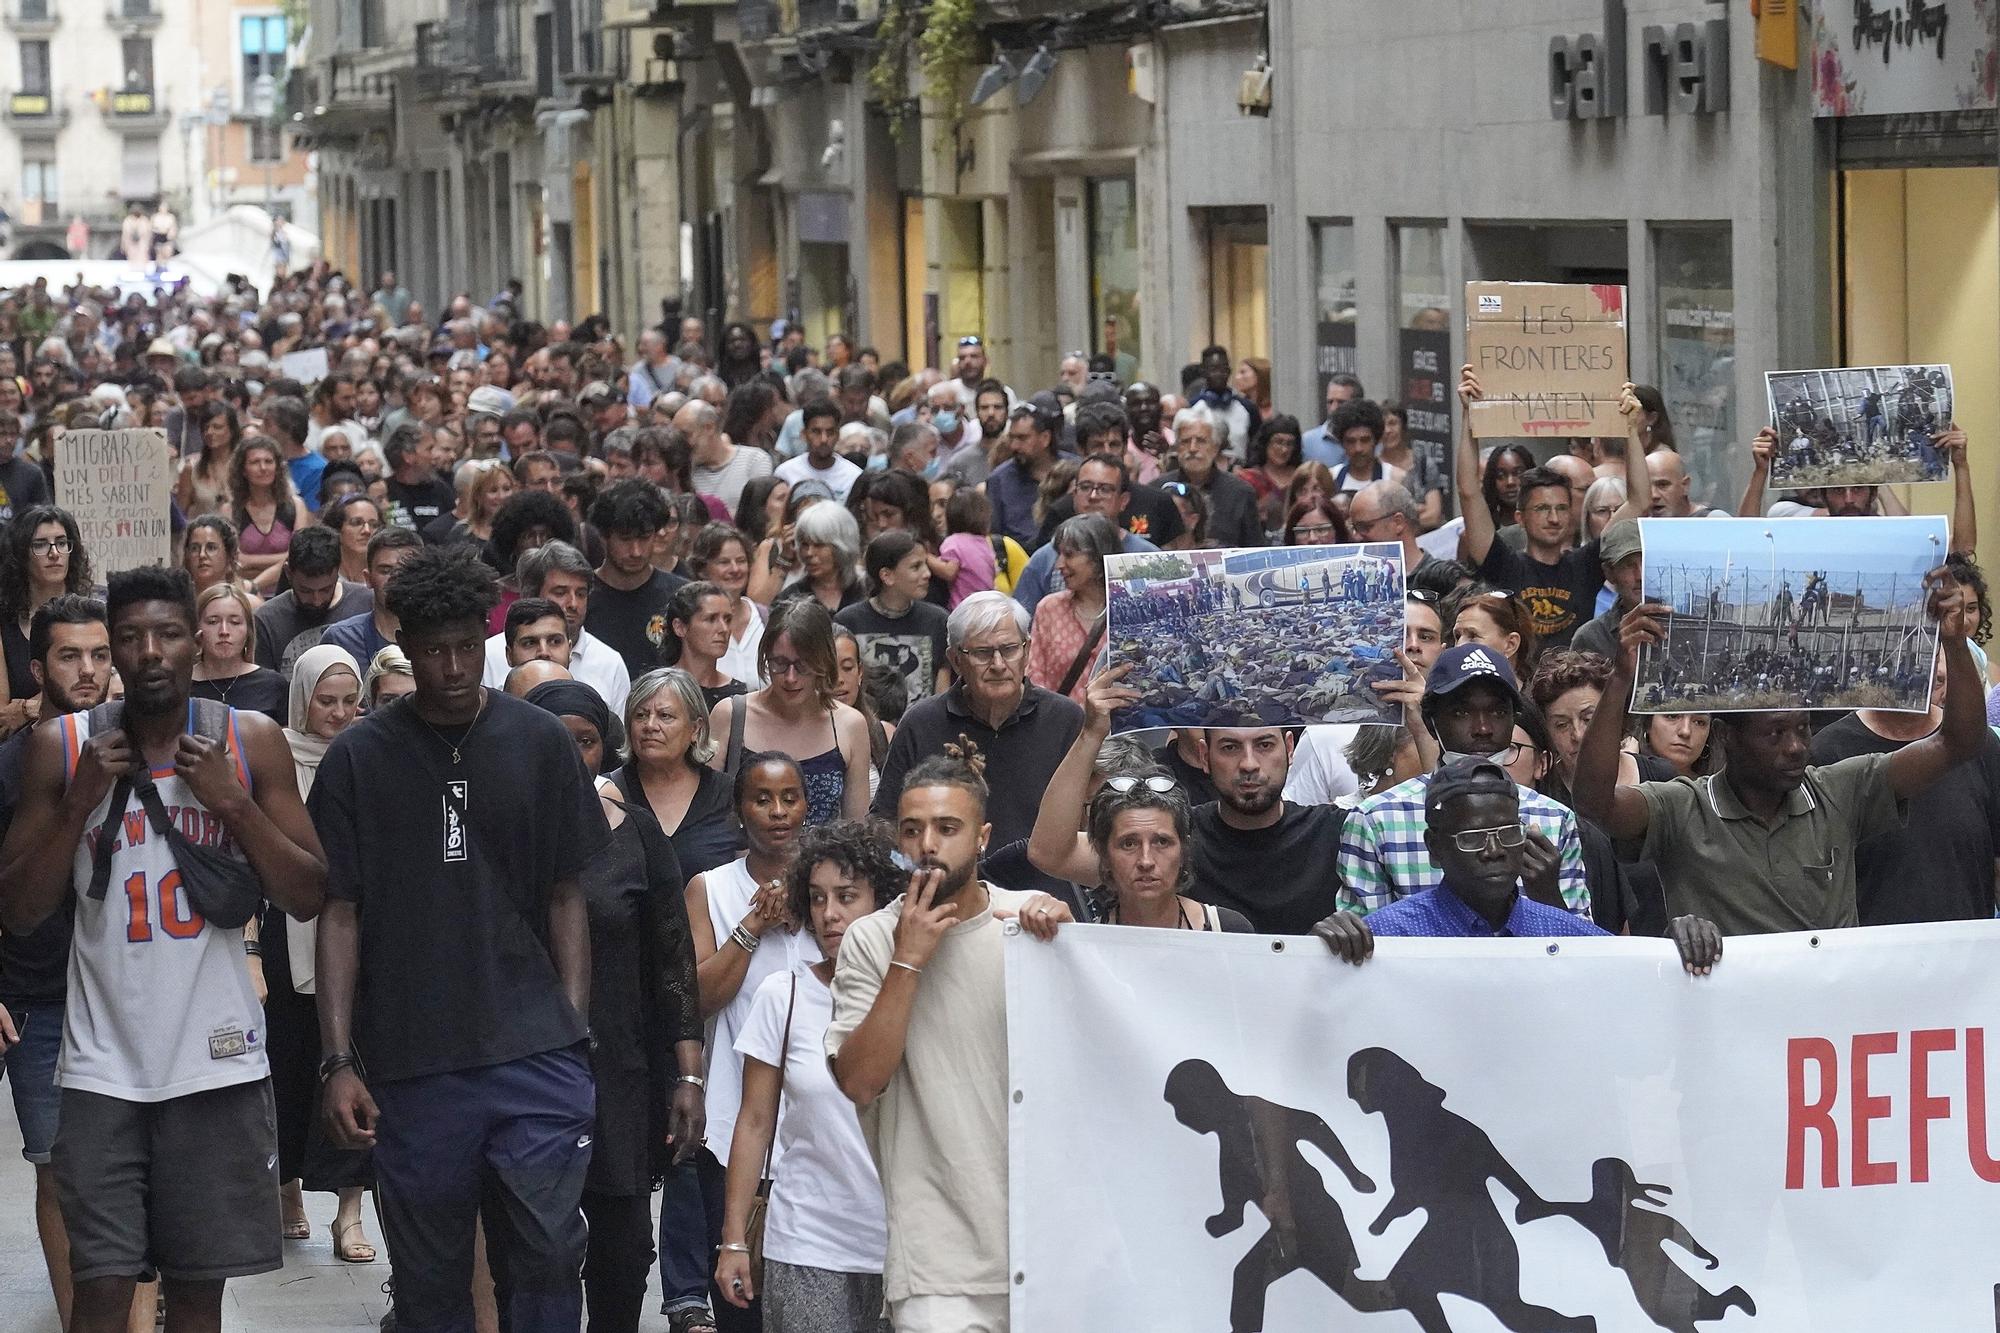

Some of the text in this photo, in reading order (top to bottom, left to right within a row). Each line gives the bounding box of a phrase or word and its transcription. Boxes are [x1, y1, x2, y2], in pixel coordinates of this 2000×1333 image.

[1523, 305, 1574, 335] LES
[1480, 345, 1613, 371] FRONTERES
[1511, 391, 1595, 421] MATEN
[65, 432, 133, 465] MIGRAR
[63, 467, 89, 485] UN
[65, 483, 150, 505] MÉS SABENT
[81, 519, 166, 540] PEUS EN UN
[1460, 659, 1497, 672] adidas
[124, 869, 205, 943] 10
[1785, 1027, 2000, 1190] REFU
